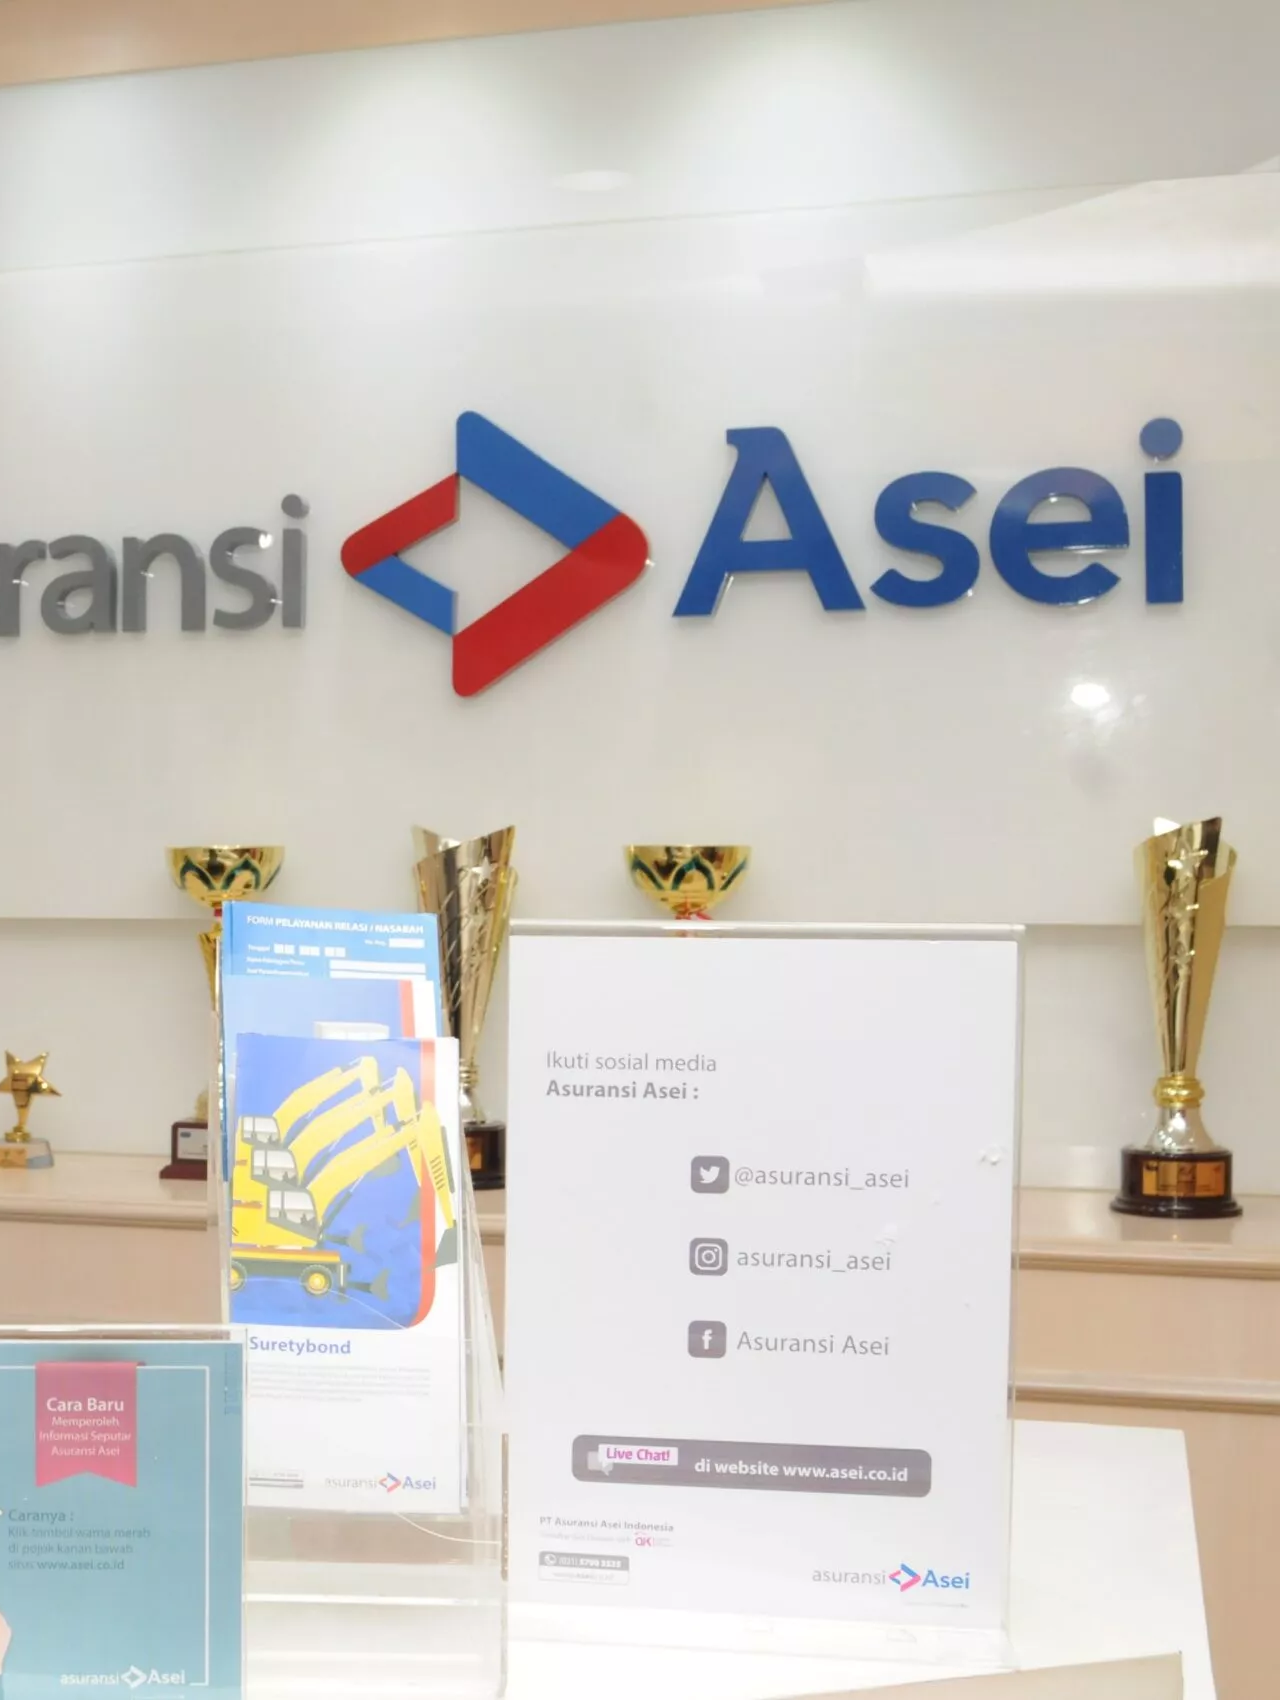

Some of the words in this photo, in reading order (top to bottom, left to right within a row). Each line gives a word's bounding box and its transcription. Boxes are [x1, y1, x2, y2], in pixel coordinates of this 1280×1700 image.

[672, 417, 1184, 618] Asei
[246, 915, 273, 926] FORM
[275, 917, 333, 930] PELAYANAN
[334, 921, 368, 933] RELASI
[546, 1050, 590, 1070] Ikuti
[595, 1053, 649, 1071] sosial
[655, 1054, 717, 1072] media
[546, 1079, 637, 1099] Asuransi
[643, 1081, 687, 1100] Asei
[734, 1166, 910, 1191] @asuransi_asei
[736, 1250, 891, 1273] asuransi_asei
[249, 1335, 352, 1355] Suretybond
[736, 1330, 835, 1354] Asuransi
[841, 1335, 890, 1356] Asei
[46, 1397, 83, 1412] Cara
[87, 1397, 125, 1412] Baru
[51, 1416, 120, 1428] Memperoleh
[39, 1430, 88, 1441] Informasi
[90, 1430, 131, 1442] Seputar
[51, 1446, 97, 1456] Asuransi
[98, 1446, 120, 1456] Asei
[606, 1447, 633, 1460] Live
[637, 1449, 670, 1461] Chat!
[695, 1458, 711, 1473] di
[715, 1460, 780, 1476] website
[783, 1464, 908, 1482] www.asei.co.id
[324, 1477, 378, 1489] asuransi
[402, 1475, 437, 1490] Asei
[8, 1508, 66, 1525] Caranya
[539, 1516, 552, 1525] PT
[555, 1517, 598, 1528] Asuransi
[601, 1520, 621, 1529] Asei
[624, 1521, 674, 1533] Indonesia
[8, 1543, 19, 1554] di
[57, 1543, 92, 1554] kanan
[812, 1569, 886, 1585] asuransi
[921, 1569, 970, 1589] Asei
[60, 1672, 119, 1685] asuransi
[147, 1669, 186, 1685] Asei
